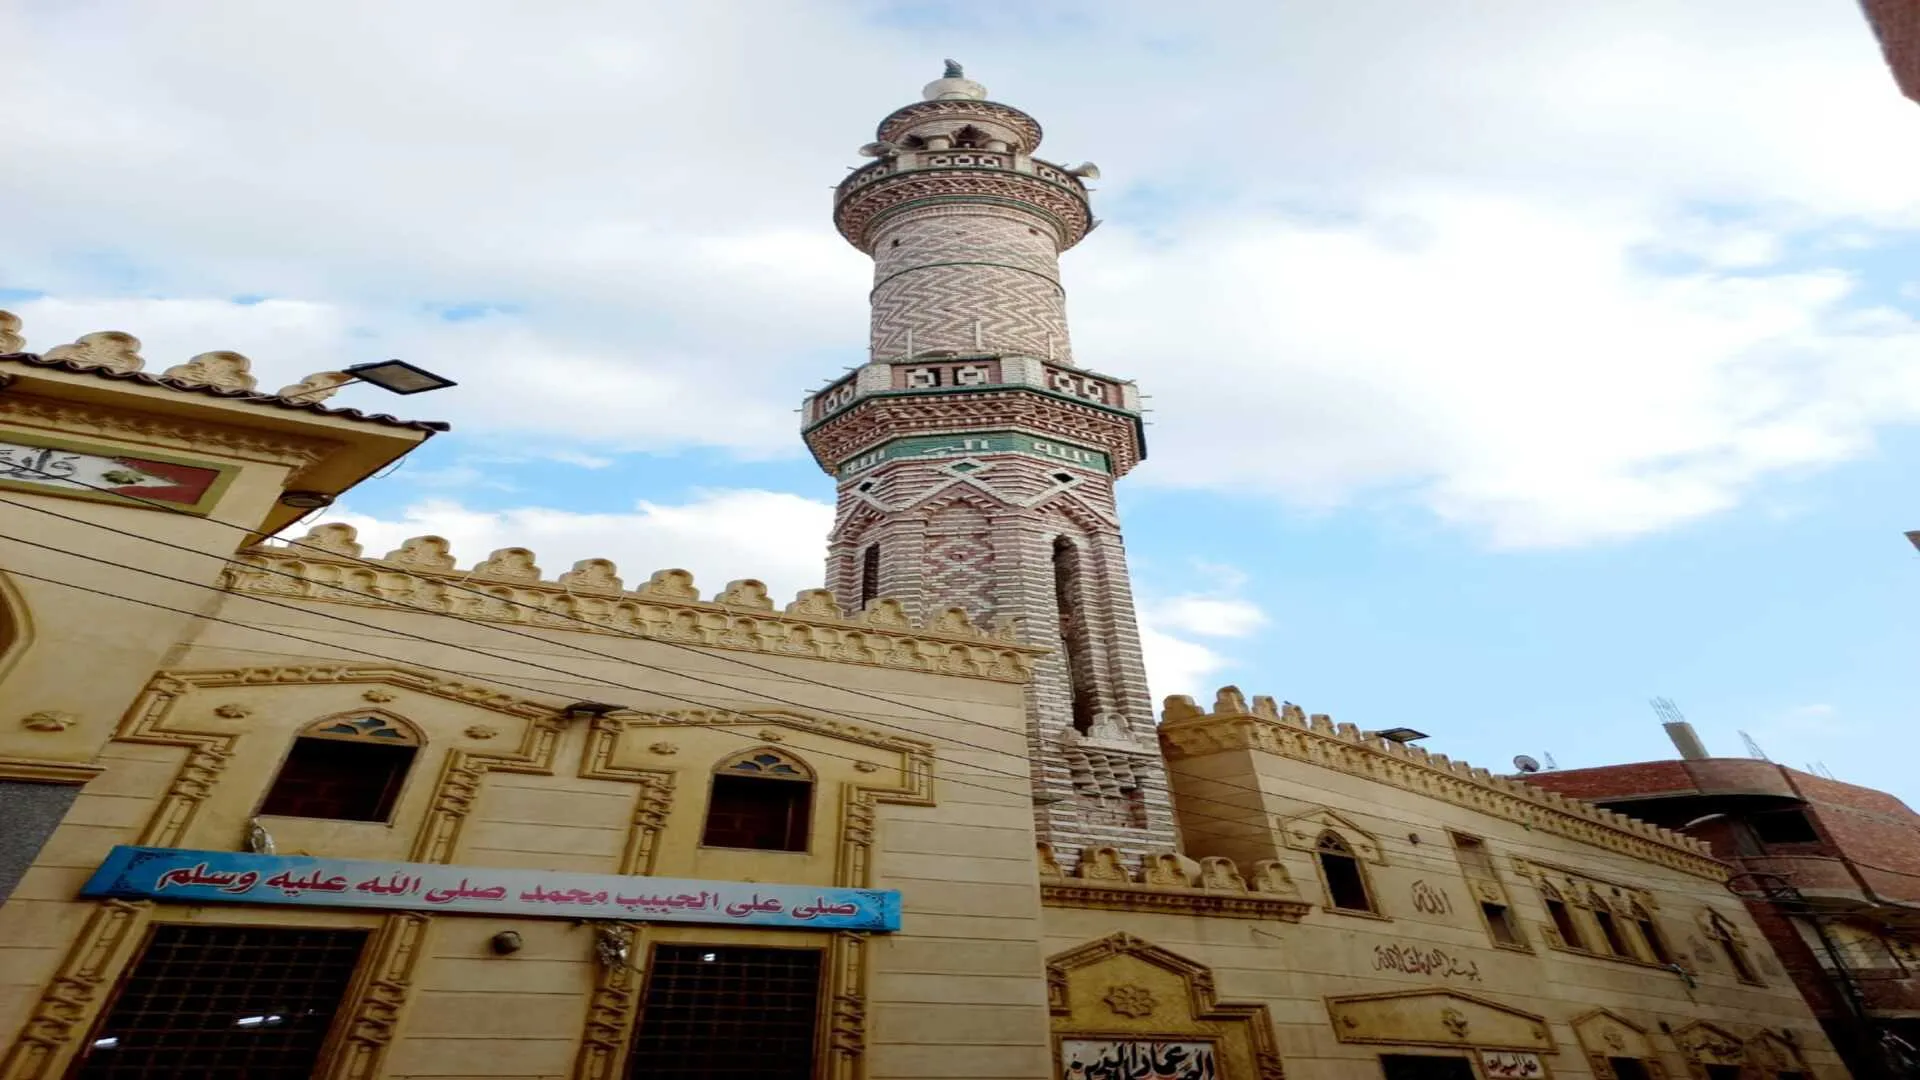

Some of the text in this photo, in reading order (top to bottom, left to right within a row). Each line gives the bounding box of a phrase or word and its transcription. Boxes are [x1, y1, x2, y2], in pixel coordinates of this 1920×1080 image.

[155, 862, 858, 920] صلى على الحبيب محمد صلى الله عليه وسلم
[1410, 879, 1454, 915] الله
